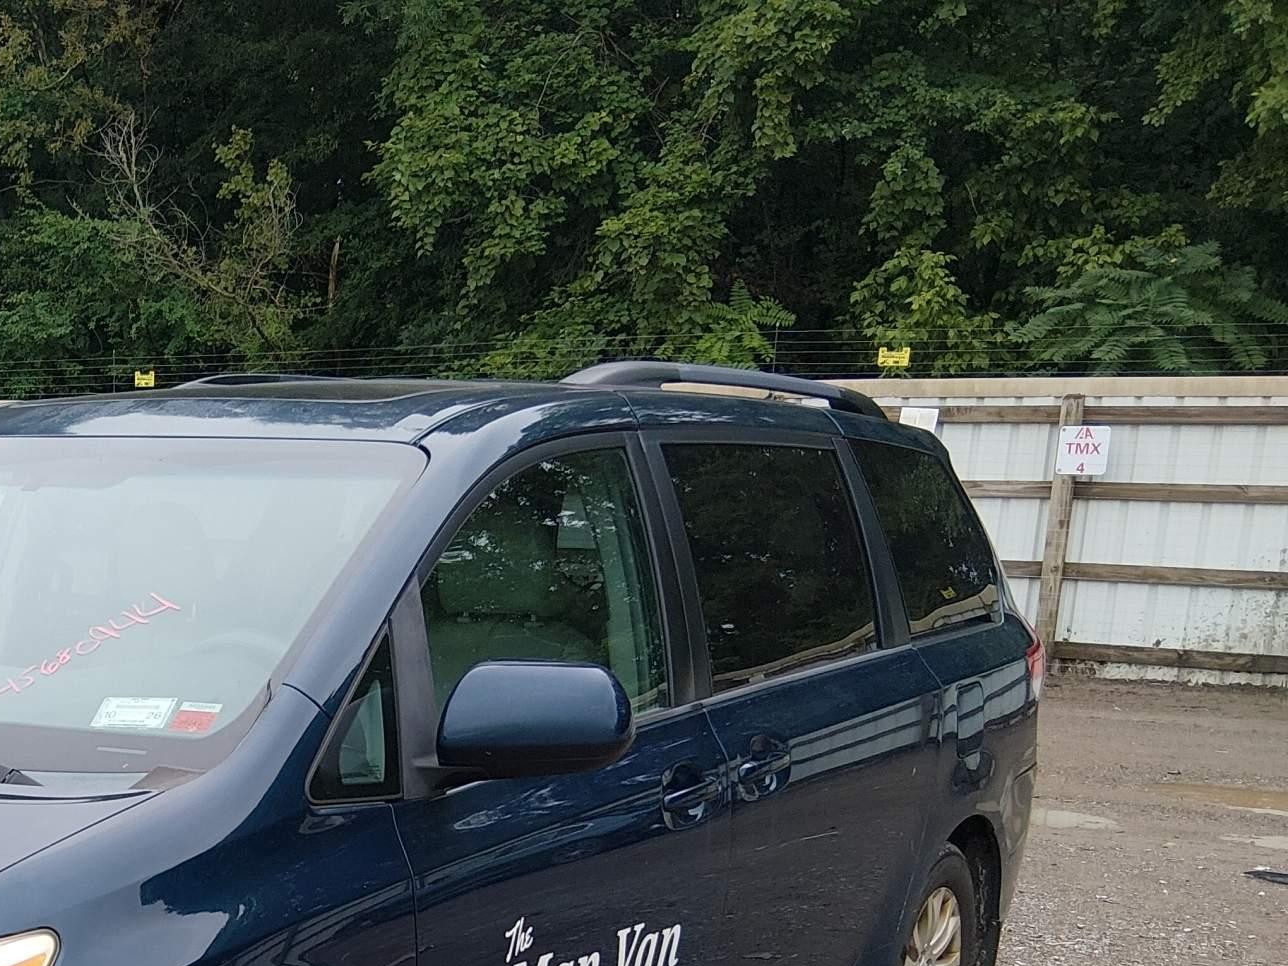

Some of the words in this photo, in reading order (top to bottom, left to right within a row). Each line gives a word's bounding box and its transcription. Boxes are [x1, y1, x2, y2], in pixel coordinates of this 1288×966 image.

[1065, 442, 1102, 455] TMX
[1075, 462, 1086, 474] 4
[505, 916, 534, 963] The
